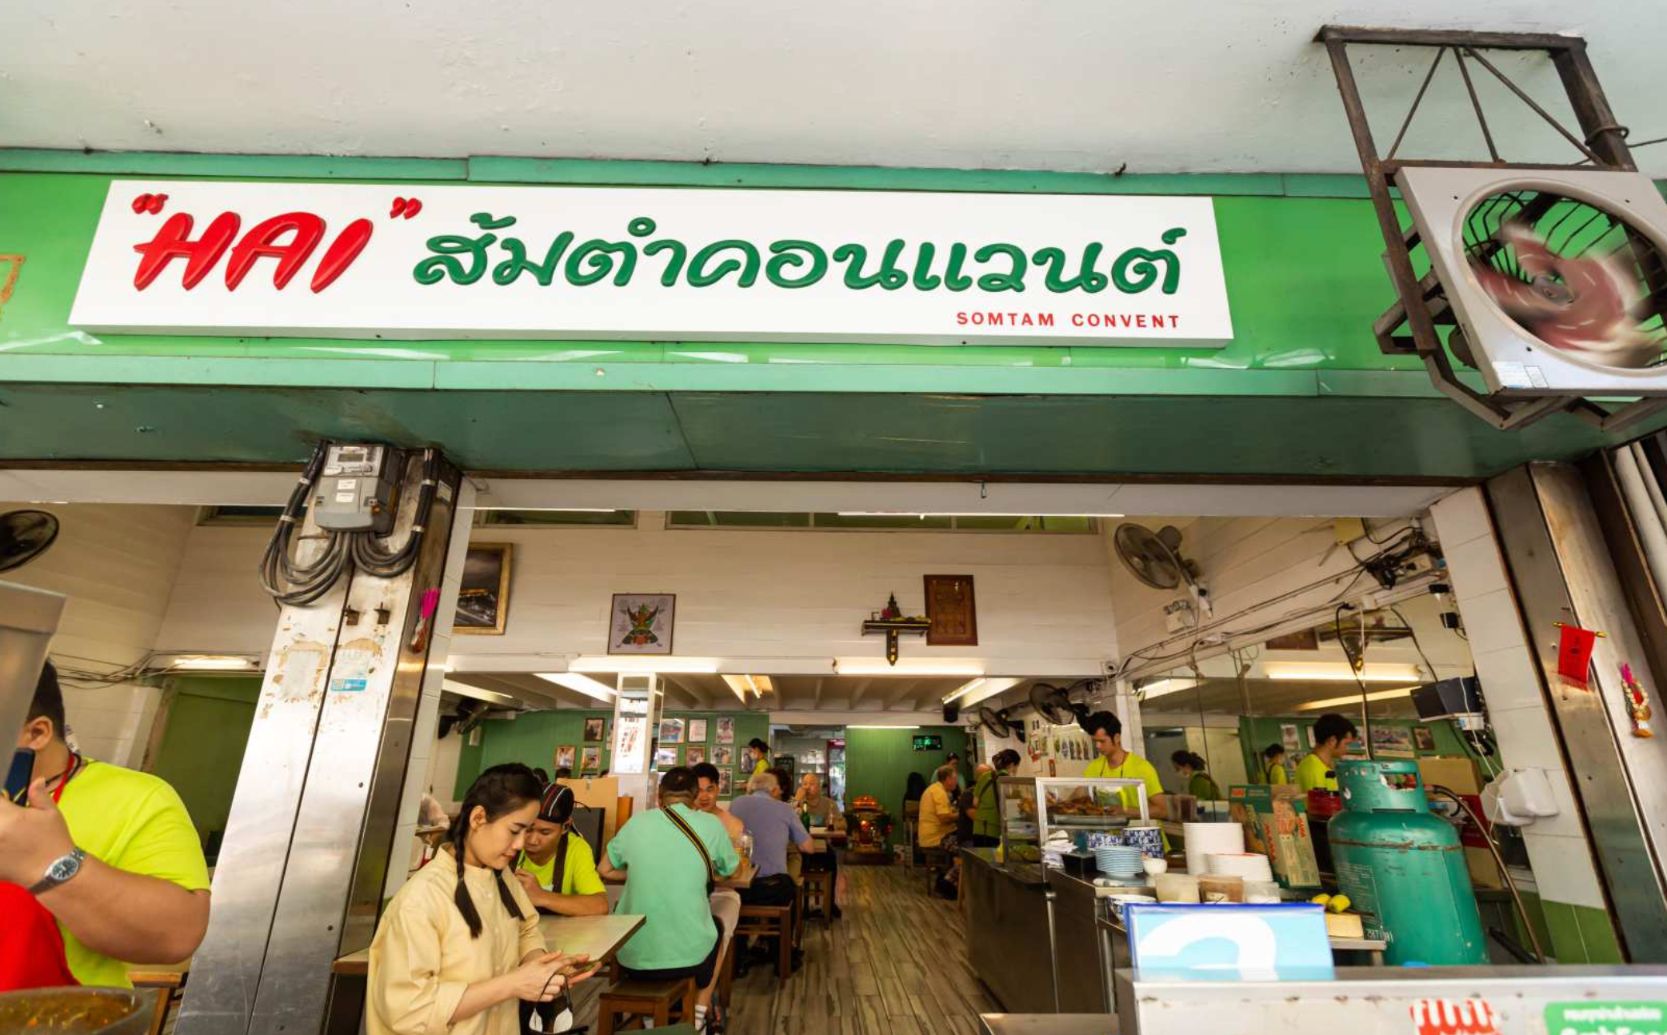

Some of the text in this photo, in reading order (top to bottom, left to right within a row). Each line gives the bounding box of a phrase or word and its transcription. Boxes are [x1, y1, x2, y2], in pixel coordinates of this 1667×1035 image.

[412, 212, 1187, 295] ส้มตำคอนแวนต์
[956, 311, 1180, 329] SOMTAM CONVENT
